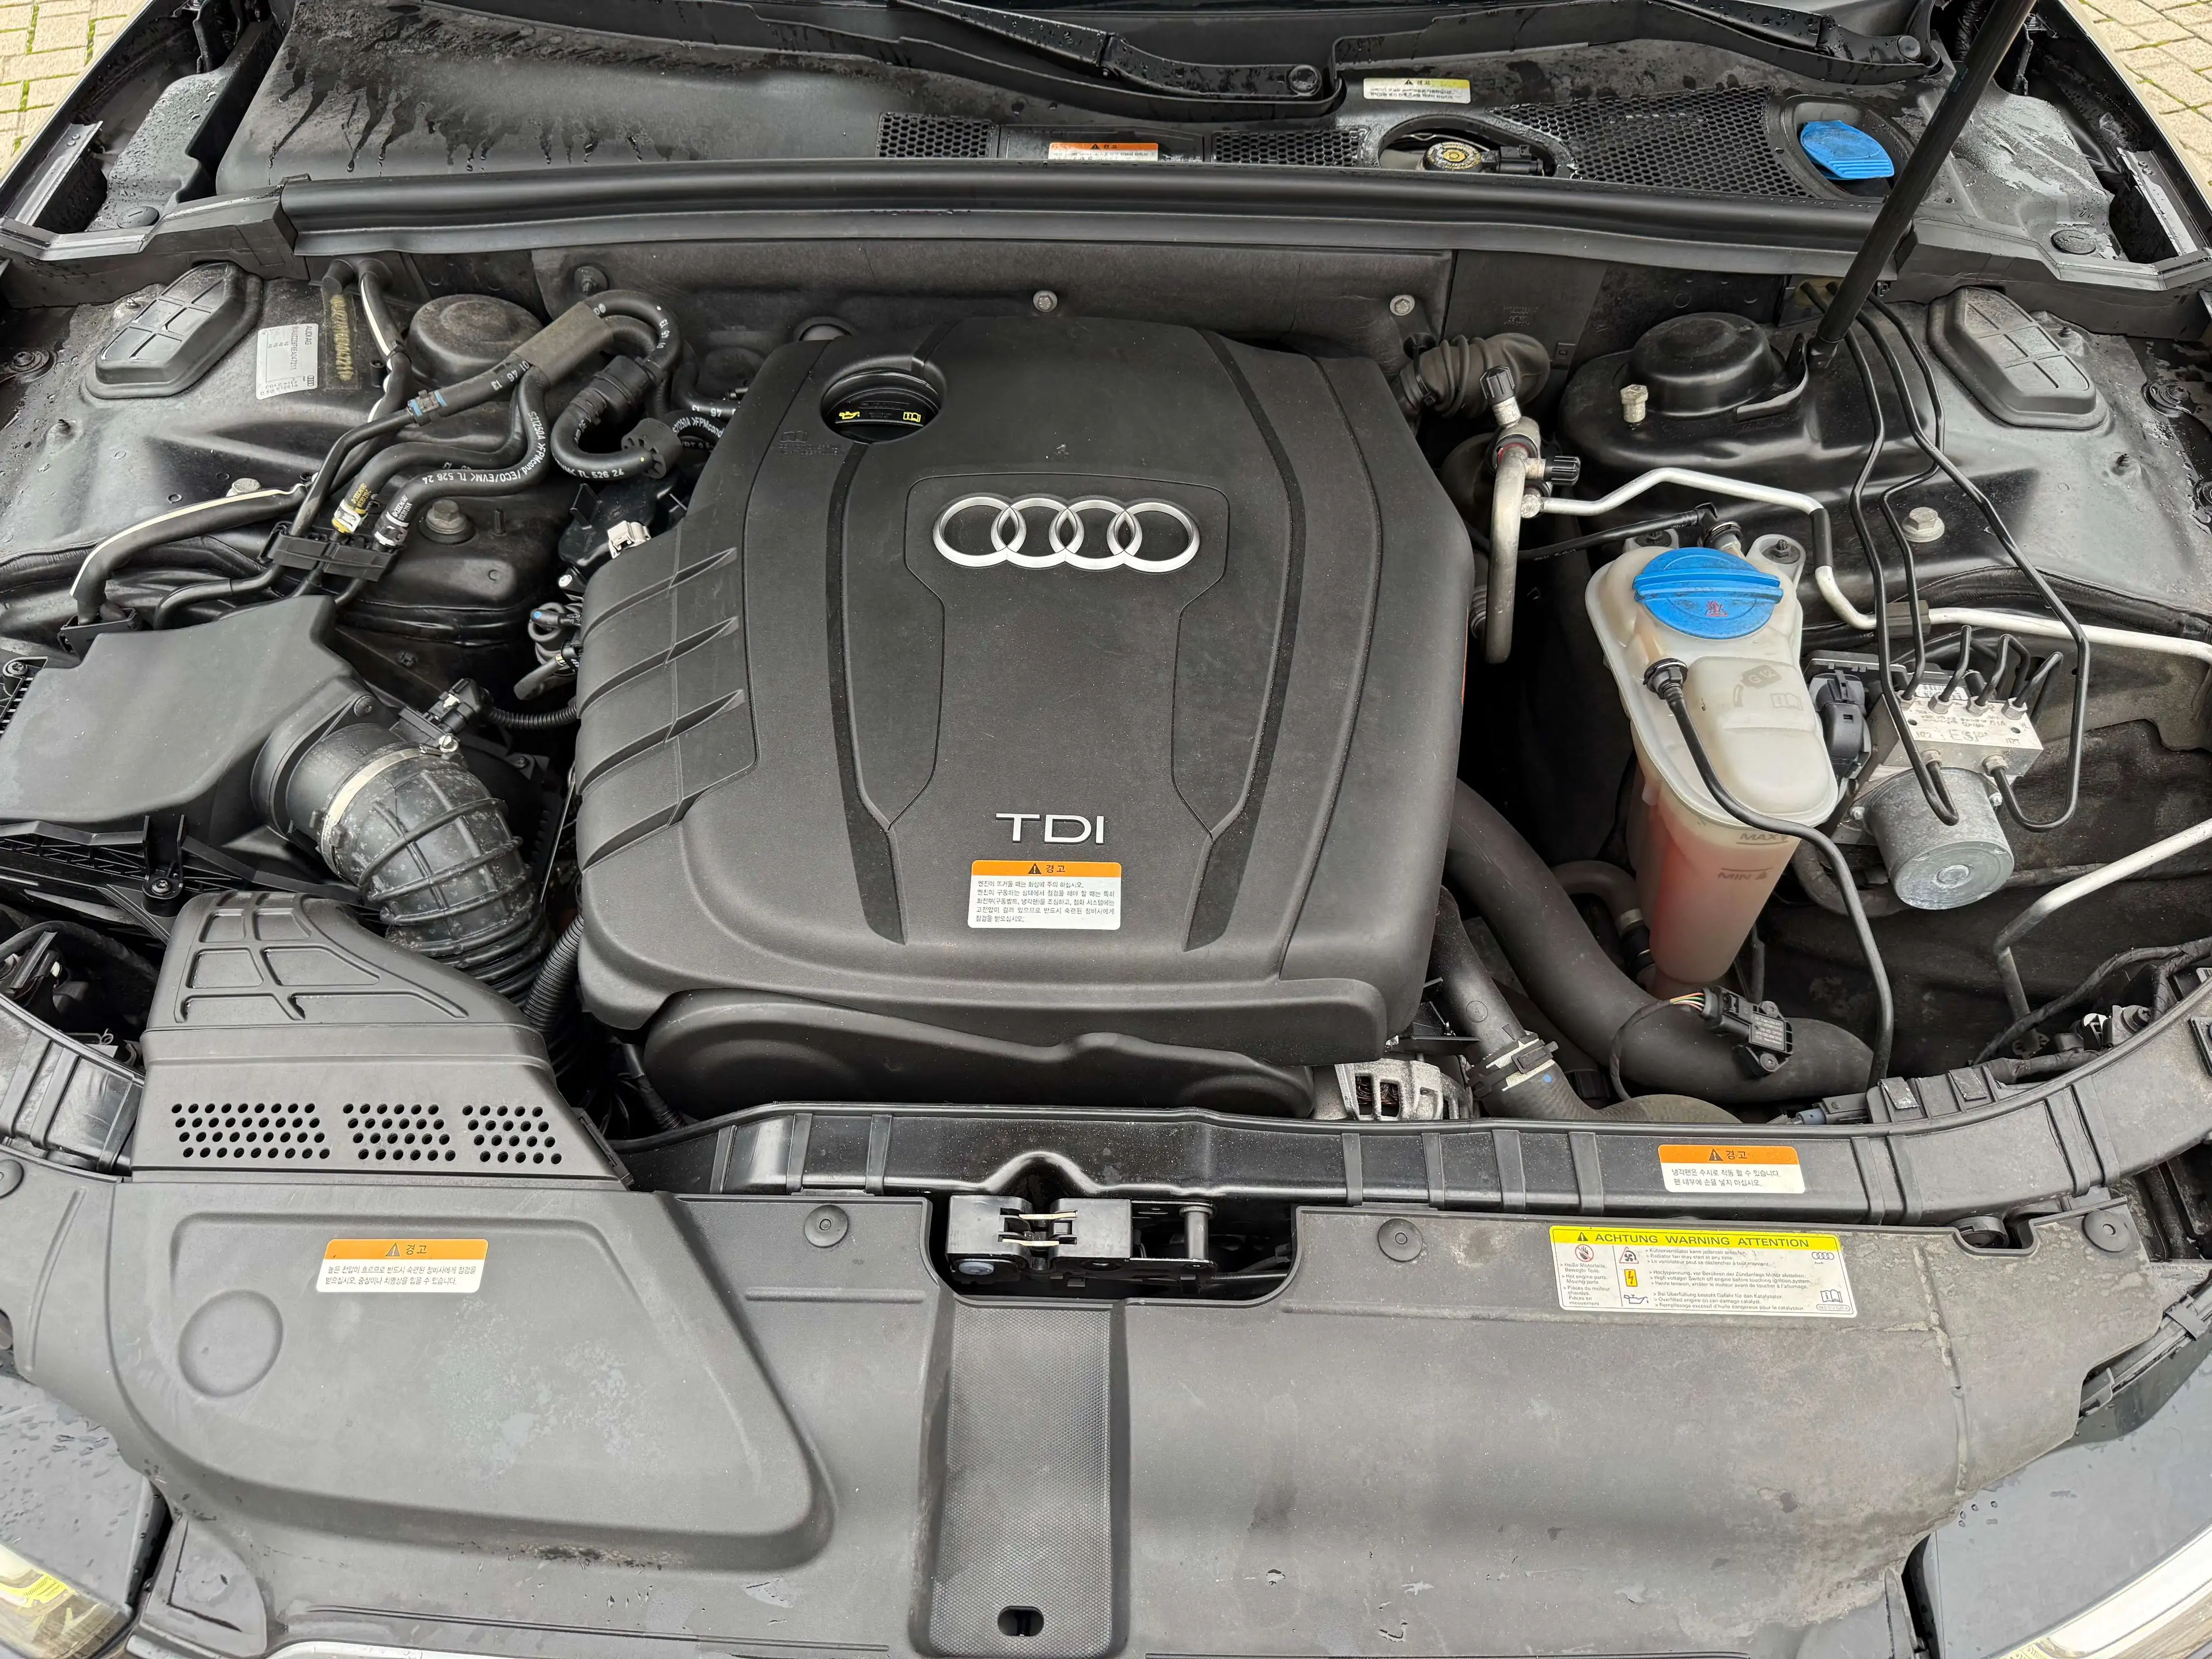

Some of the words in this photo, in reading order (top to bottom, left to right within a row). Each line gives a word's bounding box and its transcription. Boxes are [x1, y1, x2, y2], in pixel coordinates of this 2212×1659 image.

[518, 359, 530, 372] 01
[506, 369, 518, 382] 46
[491, 380, 503, 391] 13
[528, 411, 546, 441] S21250A
[422, 475, 434, 484] 24
[437, 472, 454, 482] 526
[578, 470, 590, 478] TL
[591, 470, 609, 479] 526
[612, 468, 624, 477] 24
[1749, 675, 1760, 683] G
[1760, 668, 1775, 678] 12
[995, 813, 1105, 844] TDI
[1717, 872, 1752, 880] MIN
[1595, 1234, 1658, 1243] ACHTUNG
[1665, 1236, 1730, 1245] WARNING
[1738, 1238, 1809, 1247] ATTENTION
